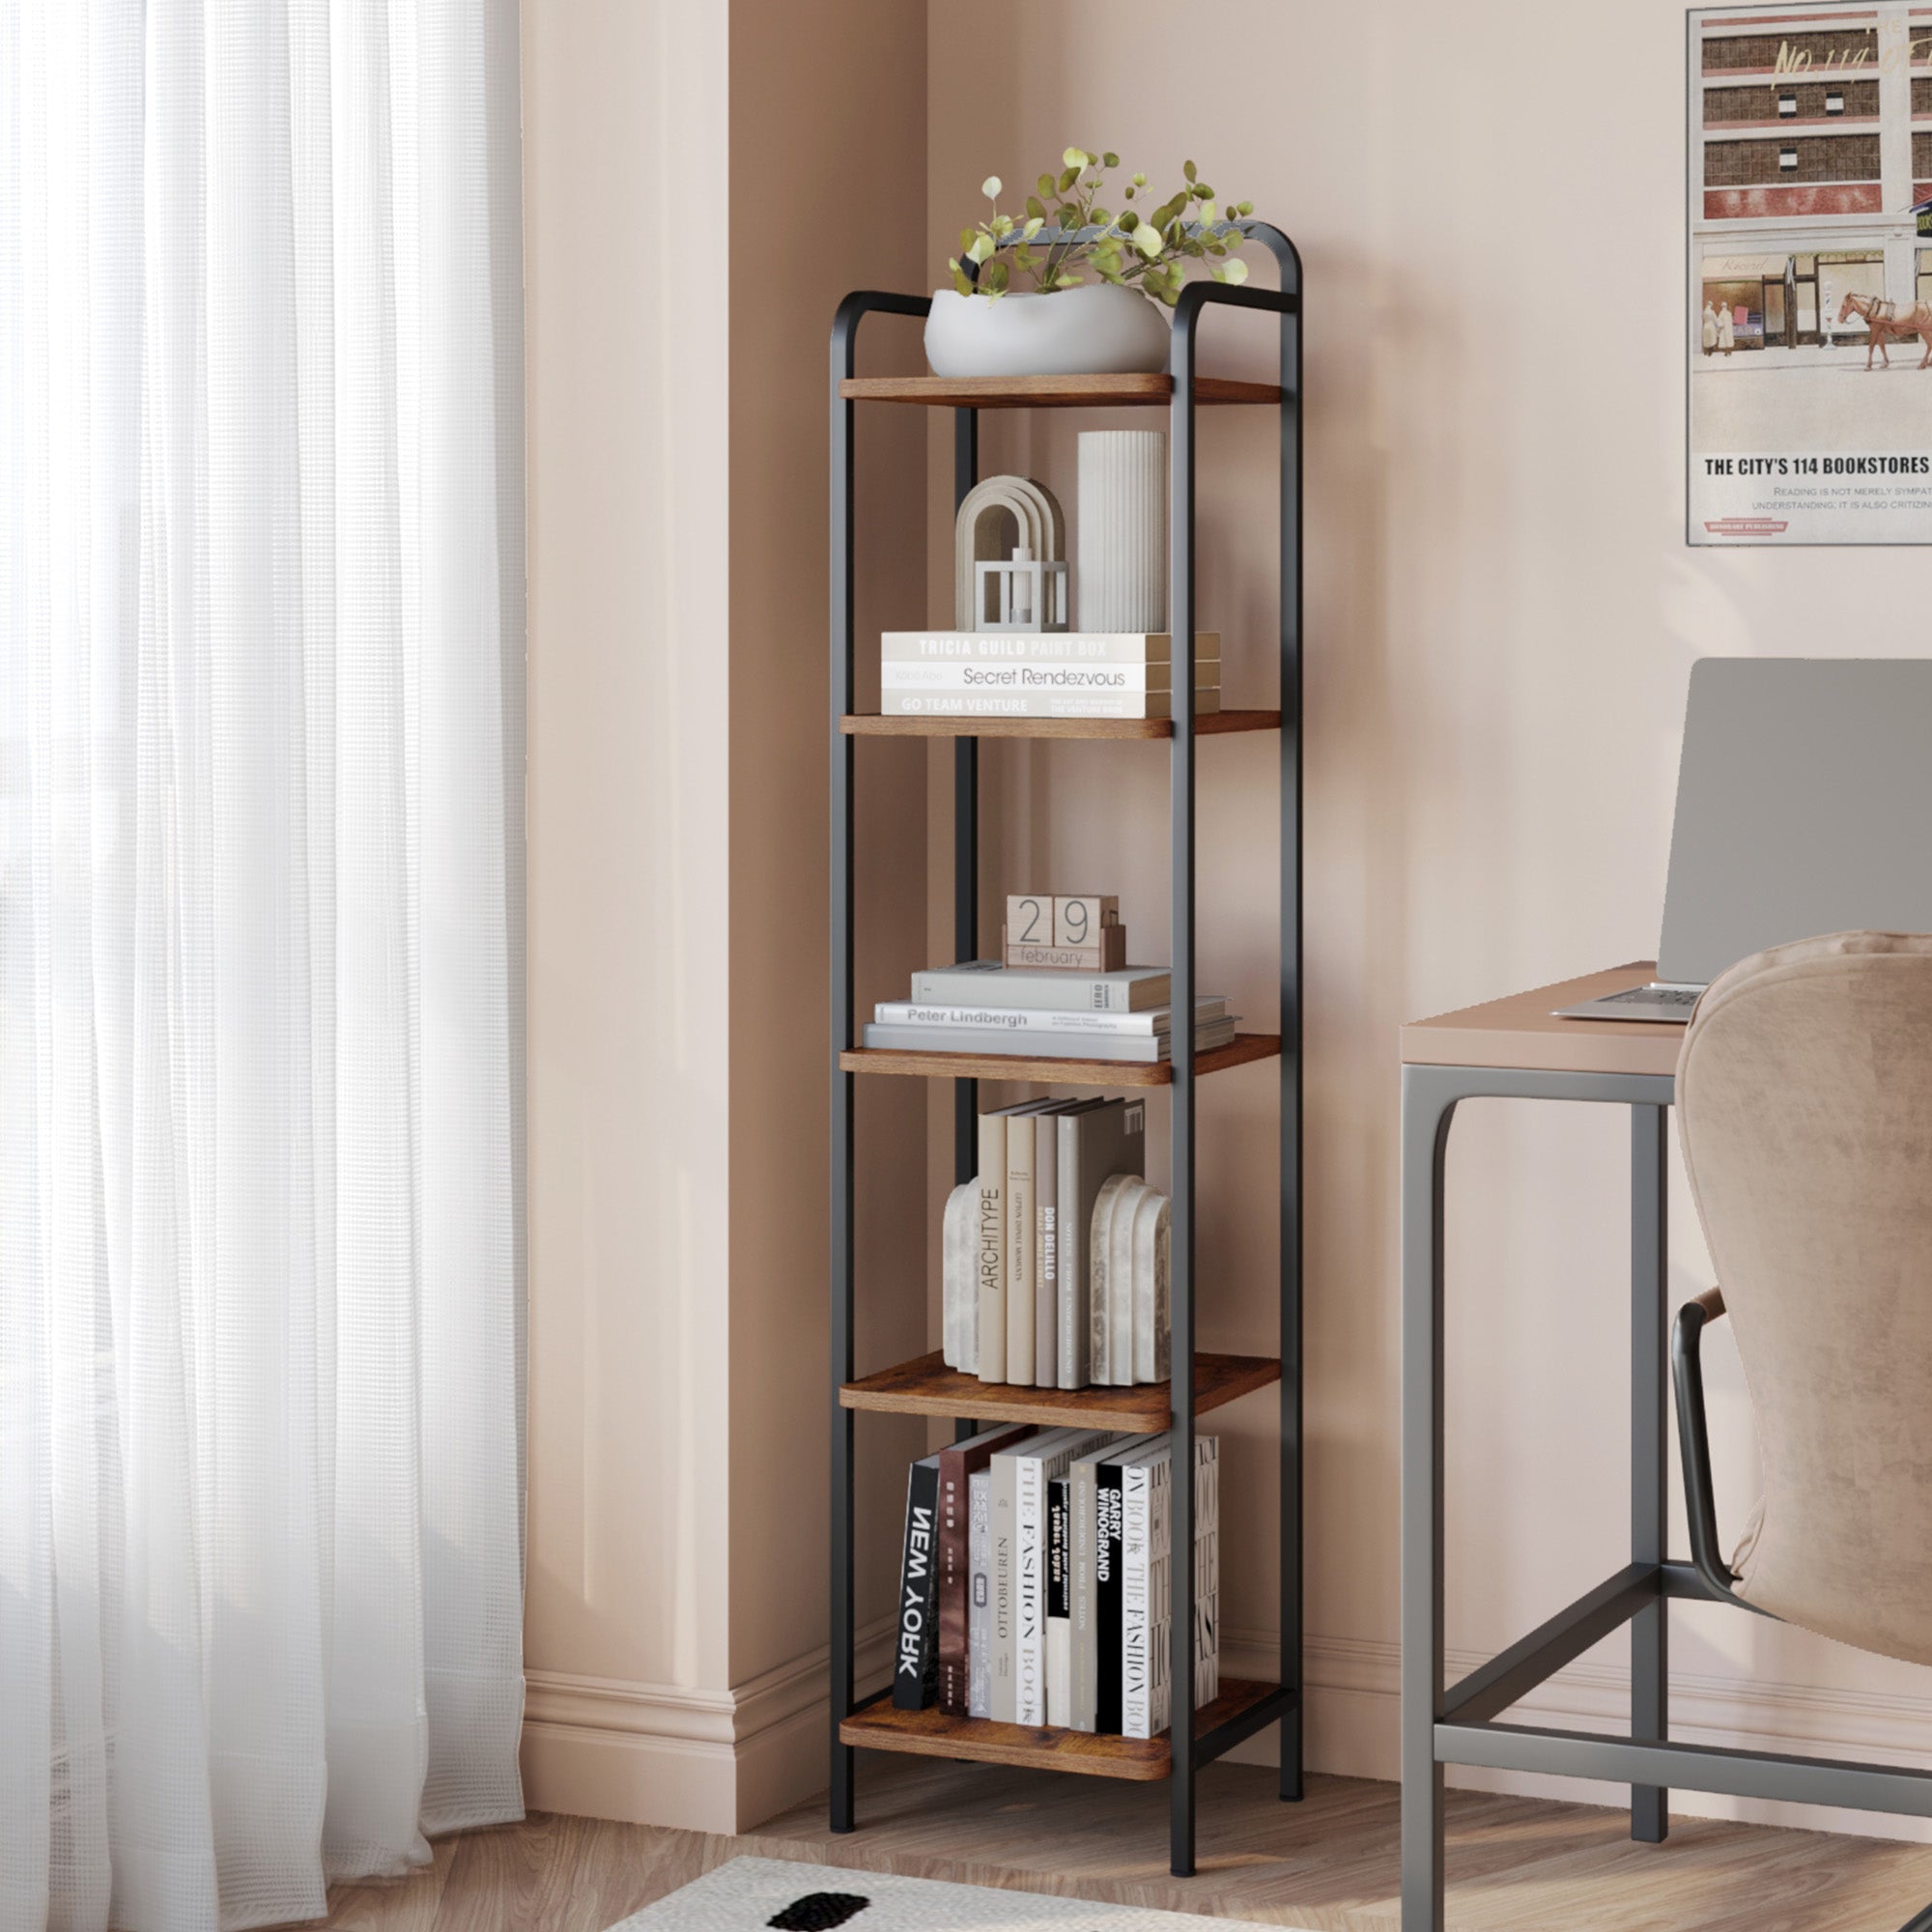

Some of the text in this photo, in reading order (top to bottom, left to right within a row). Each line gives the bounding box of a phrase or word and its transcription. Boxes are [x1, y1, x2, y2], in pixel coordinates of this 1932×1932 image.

[1705, 457, 1930, 475] THE CITY'S 114 BOOKSTORES
[1839, 501, 1847, 510] IT
[1850, 501, 1860, 510] IS
[1861, 501, 1888, 510] ALSO
[920, 639, 1106, 656] TRICIA GUILD PAINT BOX
[963, 668, 1125, 686] Secret Rendezvous
[901, 698, 1028, 711] GO TEAM VENTURE
[1021, 947, 1084, 967] february
[907, 1009, 1028, 1027] Peter Lindbergh
[981, 1188, 999, 1289] ARCHITYPE
[1044, 1207, 1055, 1280] DON DELILLO
[1022, 1460, 1036, 1517] THE
[1097, 1488, 1110, 1582] WINOGRAND
[1109, 1489, 1122, 1540] GARRY
[997, 1536, 1009, 1638] OTTOBEUREN
[1022, 1523, 1036, 1640] FASHION
[1126, 1563, 1145, 1604] THE
[1126, 1608, 1145, 1696] FASHION
